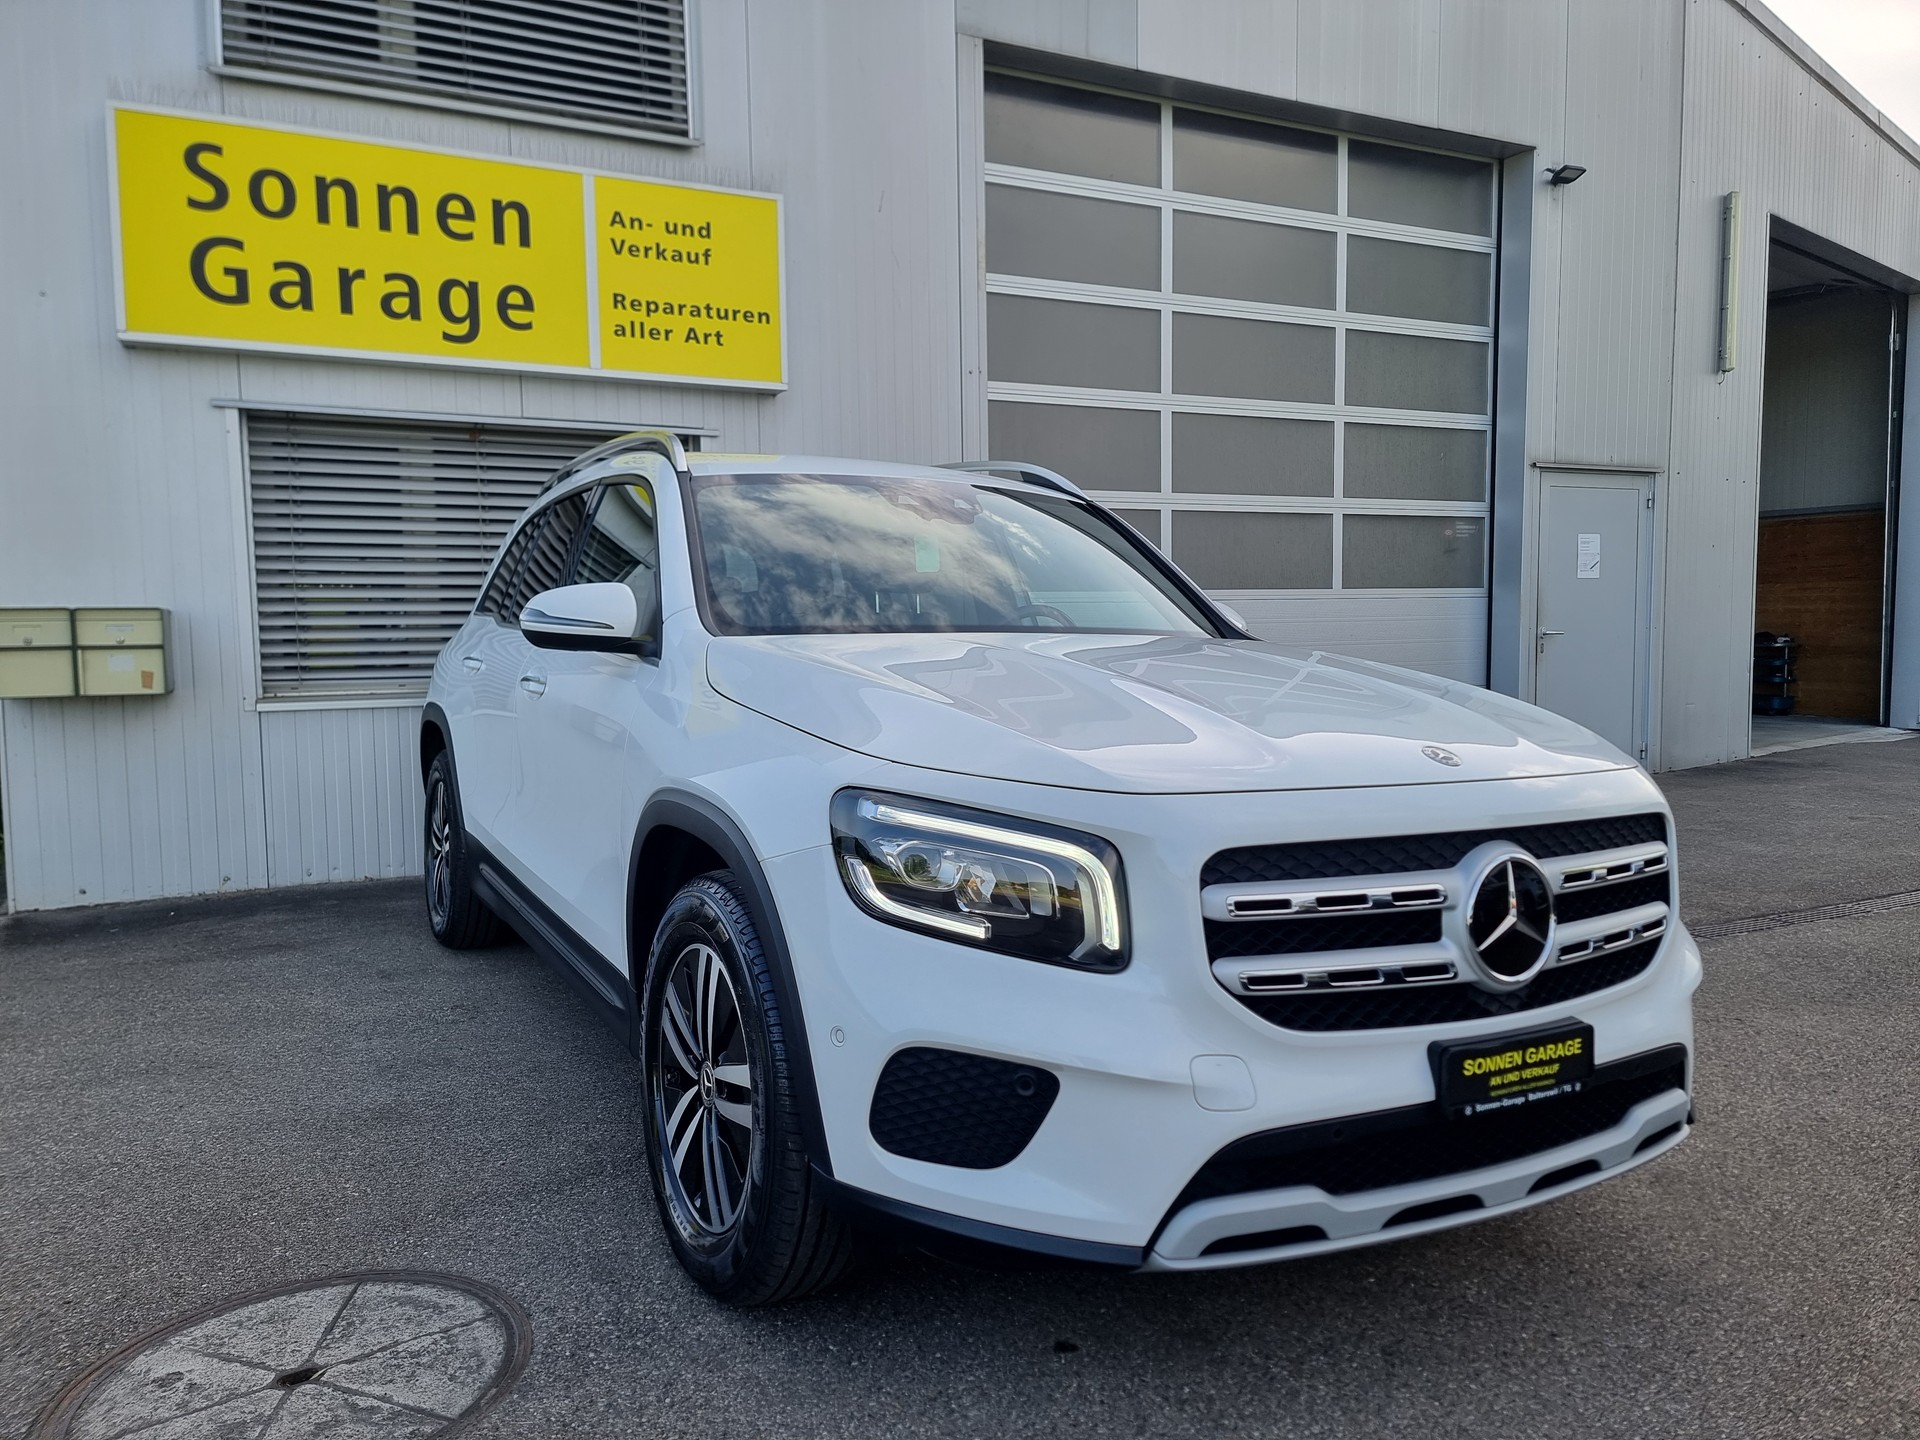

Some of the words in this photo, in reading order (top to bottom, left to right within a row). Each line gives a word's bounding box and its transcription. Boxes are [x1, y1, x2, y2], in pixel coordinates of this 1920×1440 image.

[182, 141, 532, 248] Sonnen
[609, 211, 653, 231] An-
[665, 221, 712, 240] und
[610, 237, 712, 266] Verkauf
[189, 236, 536, 345] Garage
[612, 292, 771, 325] Reparaturen
[613, 320, 674, 342] aller
[684, 327, 724, 347] Art
[1463, 1050, 1523, 1076] SONNEN
[1525, 1038, 1582, 1063] GARAGE
[1490, 1076, 1502, 1087] AN
[1503, 1071, 1521, 1083] UND
[1522, 1064, 1560, 1079] VERKAUF
